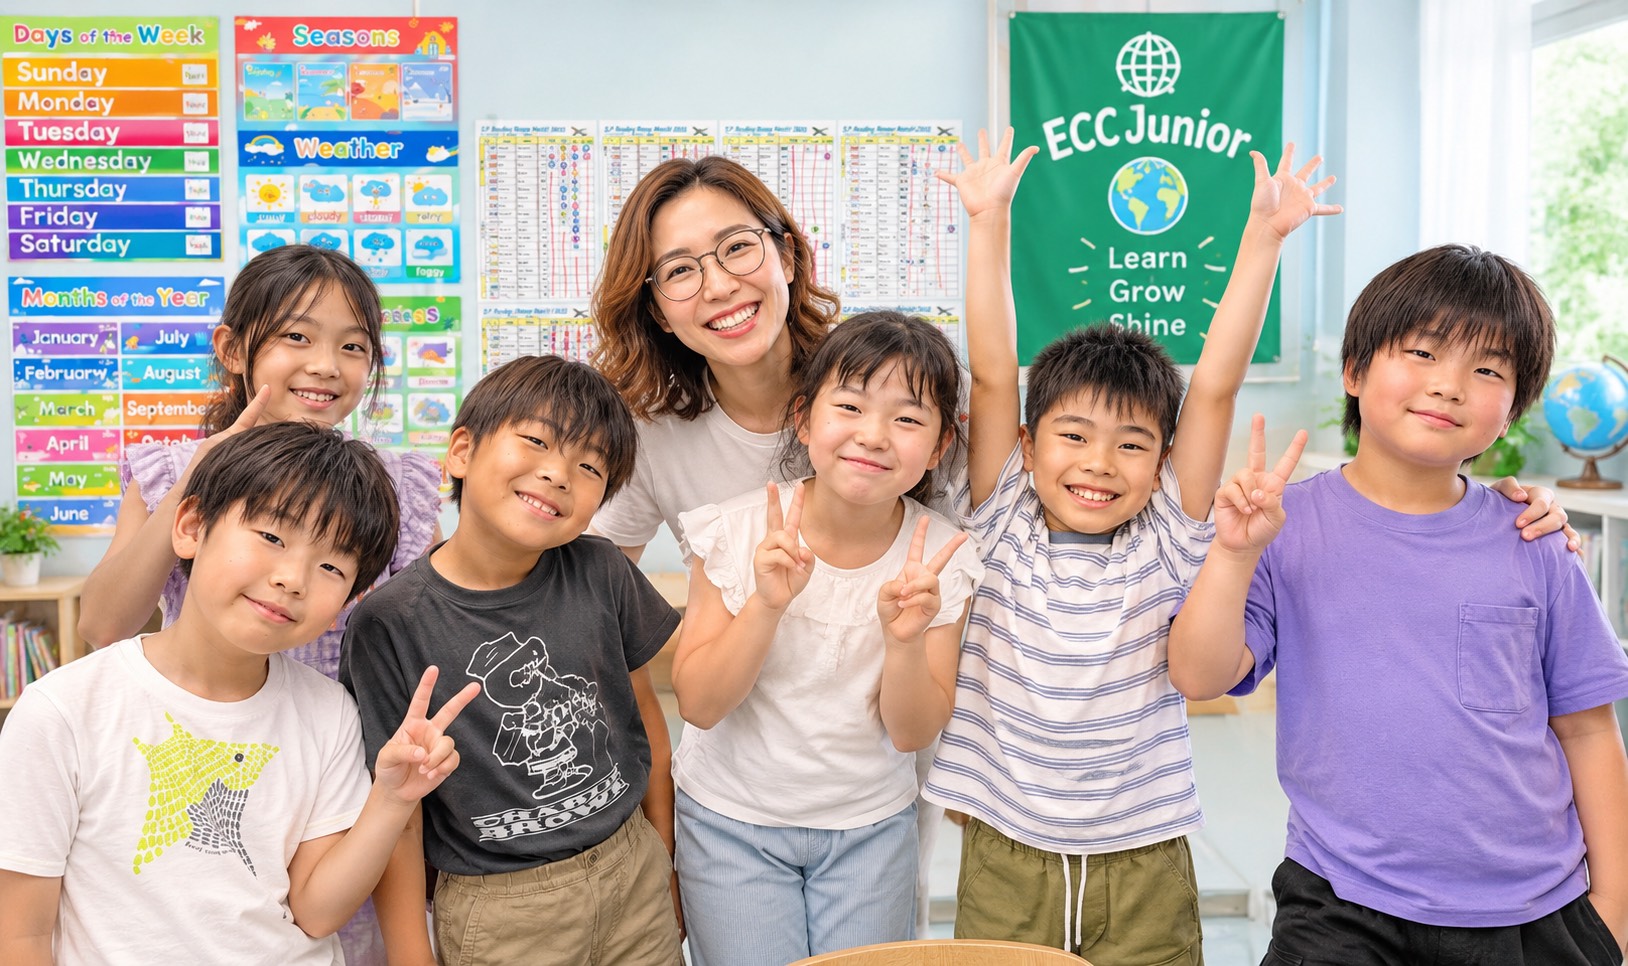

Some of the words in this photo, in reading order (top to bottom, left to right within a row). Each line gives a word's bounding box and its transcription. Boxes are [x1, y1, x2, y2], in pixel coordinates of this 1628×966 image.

[14, 24, 72, 48] Days
[80, 29, 97, 44] of
[137, 25, 205, 45] Week
[293, 24, 400, 47] Seasons
[17, 61, 107, 87] Sunday
[17, 91, 114, 116] Monday
[17, 121, 120, 146] Tuesday
[1042, 106, 1120, 161] ECC
[1125, 104, 1252, 159] Junior
[294, 137, 404, 160] Weather
[18, 150, 152, 174] Wednesday
[19, 178, 127, 201] Thursday
[20, 206, 98, 229] Friday
[20, 234, 131, 257] Saturday
[1108, 247, 1187, 269] Learn
[22, 287, 107, 307] Months
[111, 293, 128, 306] of
[131, 293, 154, 306] the
[157, 287, 209, 306] Year
[1109, 279, 1185, 302] Grow
[1108, 313, 1186, 336] Shine
[32, 330, 99, 347] January
[155, 330, 189, 347] July
[143, 366, 201, 383] August
[39, 401, 95, 416] March
[127, 400, 209, 419] Septembe
[46, 436, 89, 452] April
[49, 472, 87, 487] May
[50, 506, 89, 521] June
